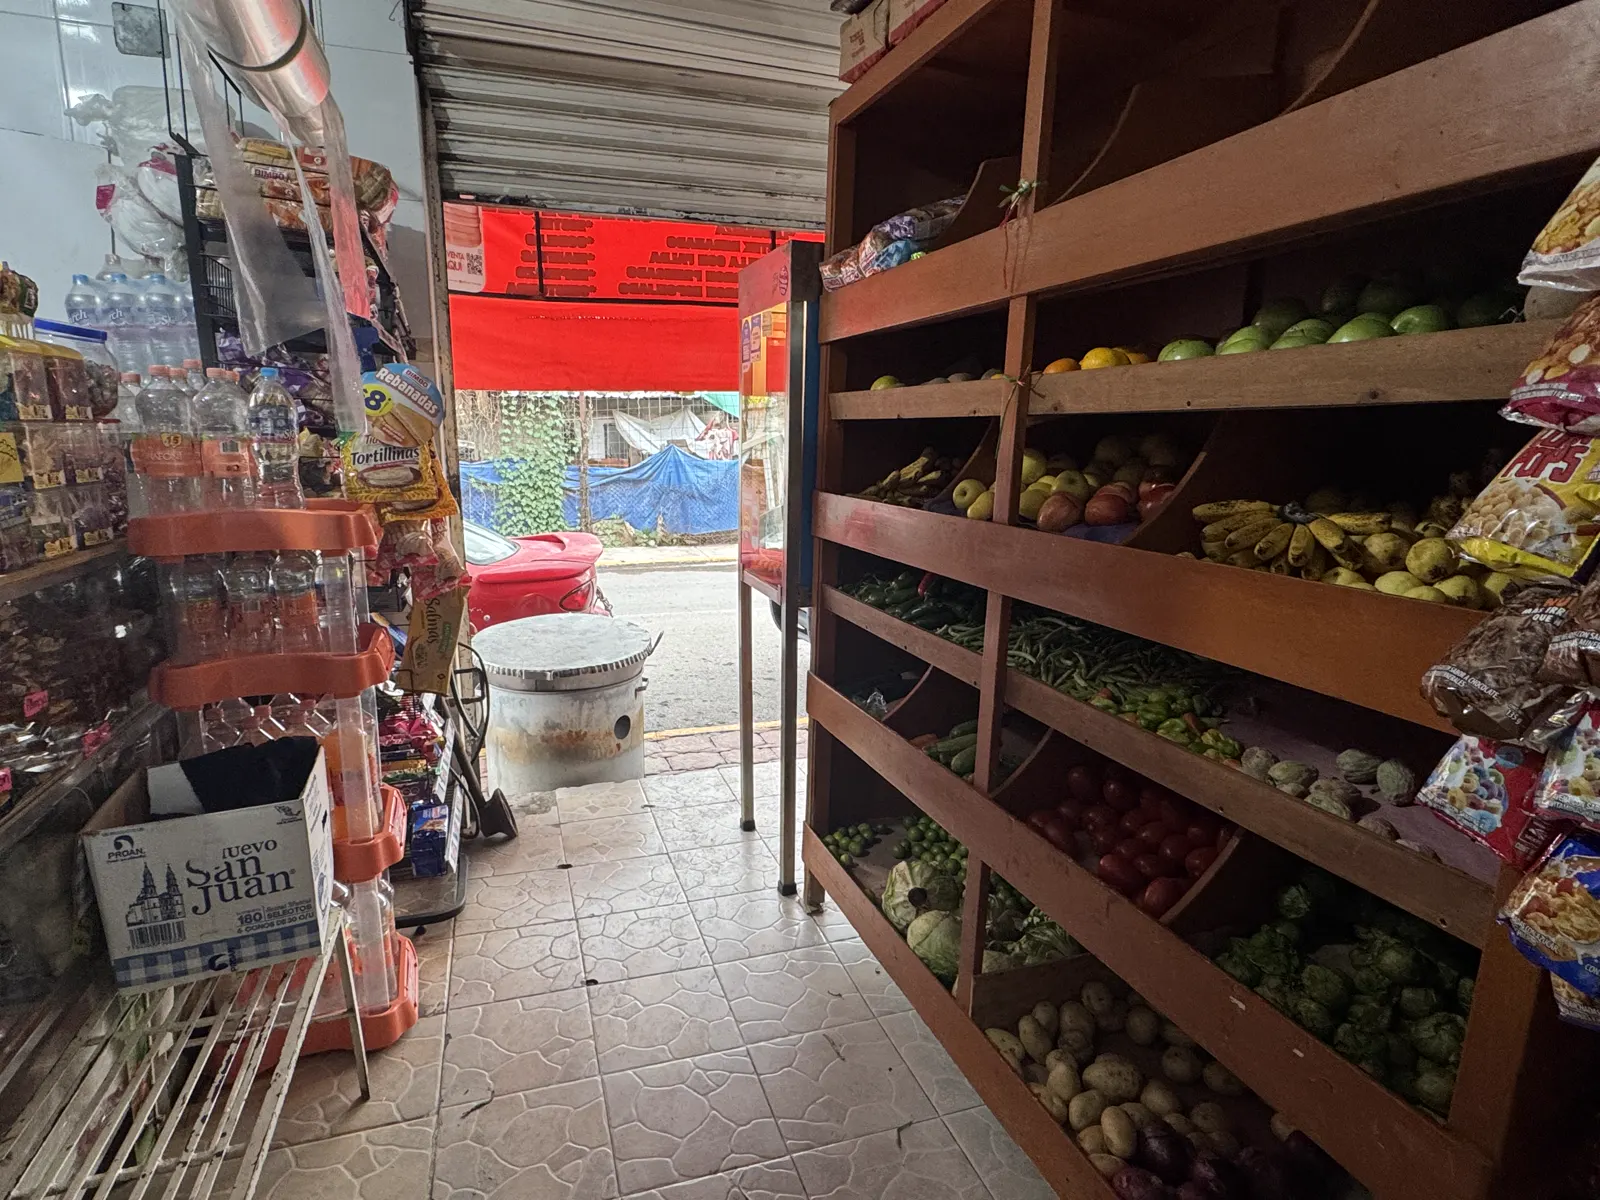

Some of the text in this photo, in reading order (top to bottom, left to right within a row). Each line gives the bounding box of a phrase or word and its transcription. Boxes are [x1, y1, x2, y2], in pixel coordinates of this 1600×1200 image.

[447, 260, 463, 272] QUI
[363, 389, 386, 411] 8
[375, 366, 440, 416] Rebanadas
[350, 447, 420, 466] Tortillinas
[1501, 445, 1590, 484] POPS
[1468, 677, 1500, 699] CHOCOLATE
[1506, 709, 1518, 721] 135
[186, 856, 264, 888] San
[192, 870, 294, 916] Juan
[238, 911, 263, 926] 180
[244, 921, 275, 933] CONOS
